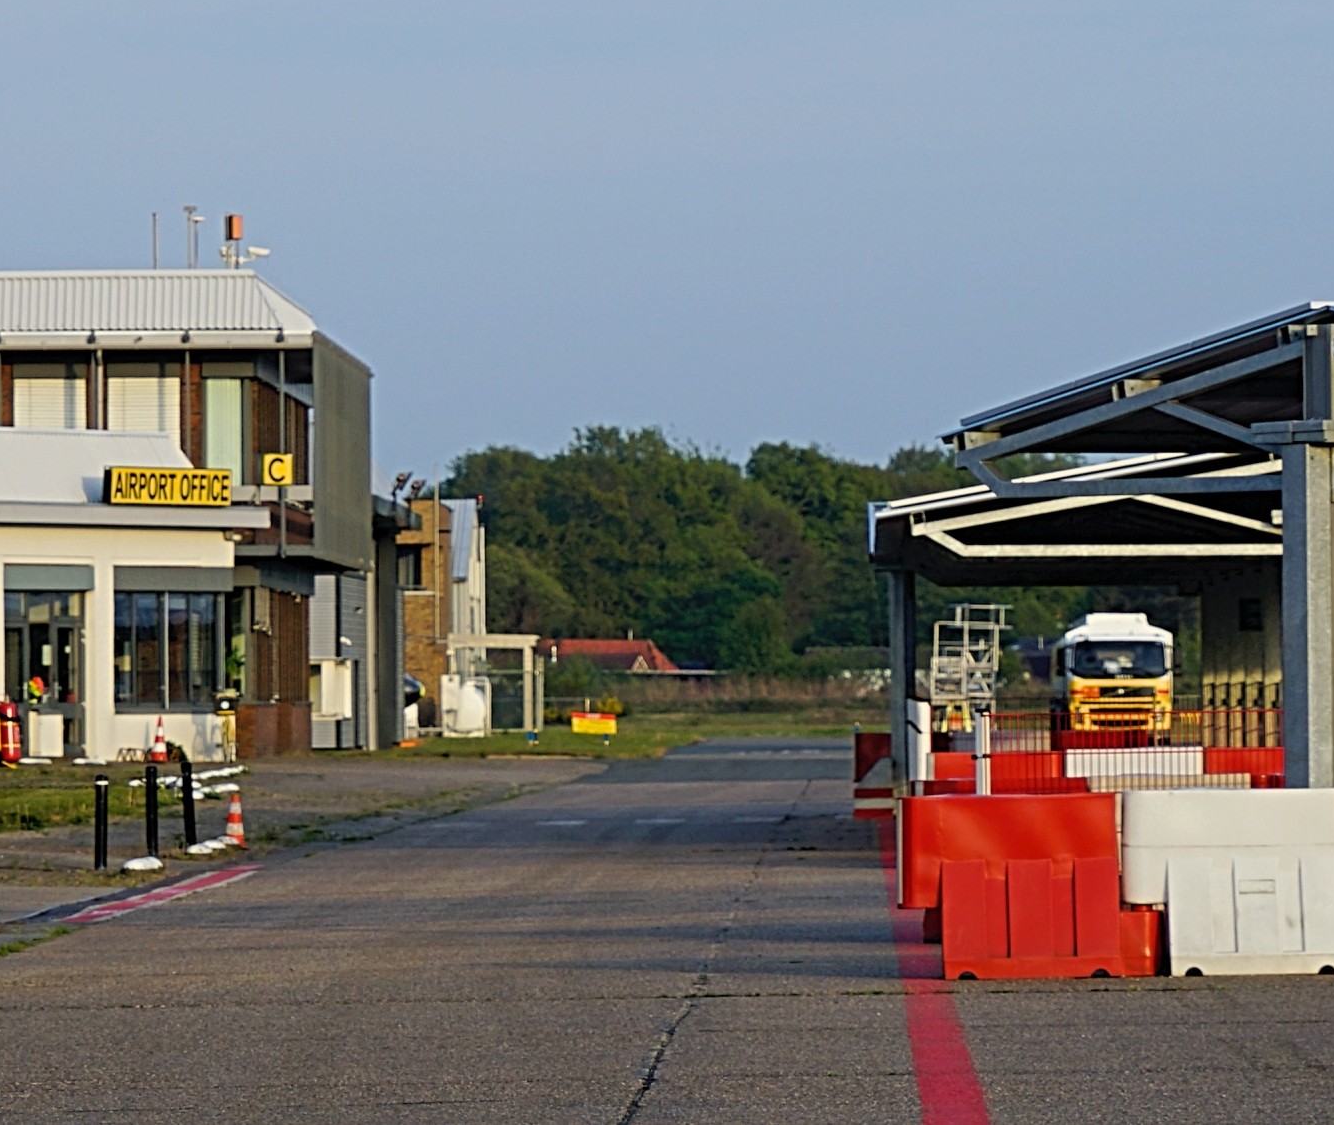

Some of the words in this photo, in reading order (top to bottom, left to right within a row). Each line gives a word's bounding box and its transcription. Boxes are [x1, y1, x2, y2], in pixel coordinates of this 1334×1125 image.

[268, 457, 285, 482] C
[114, 471, 176, 501] AIRPORT
[179, 473, 230, 502] OFFICE
